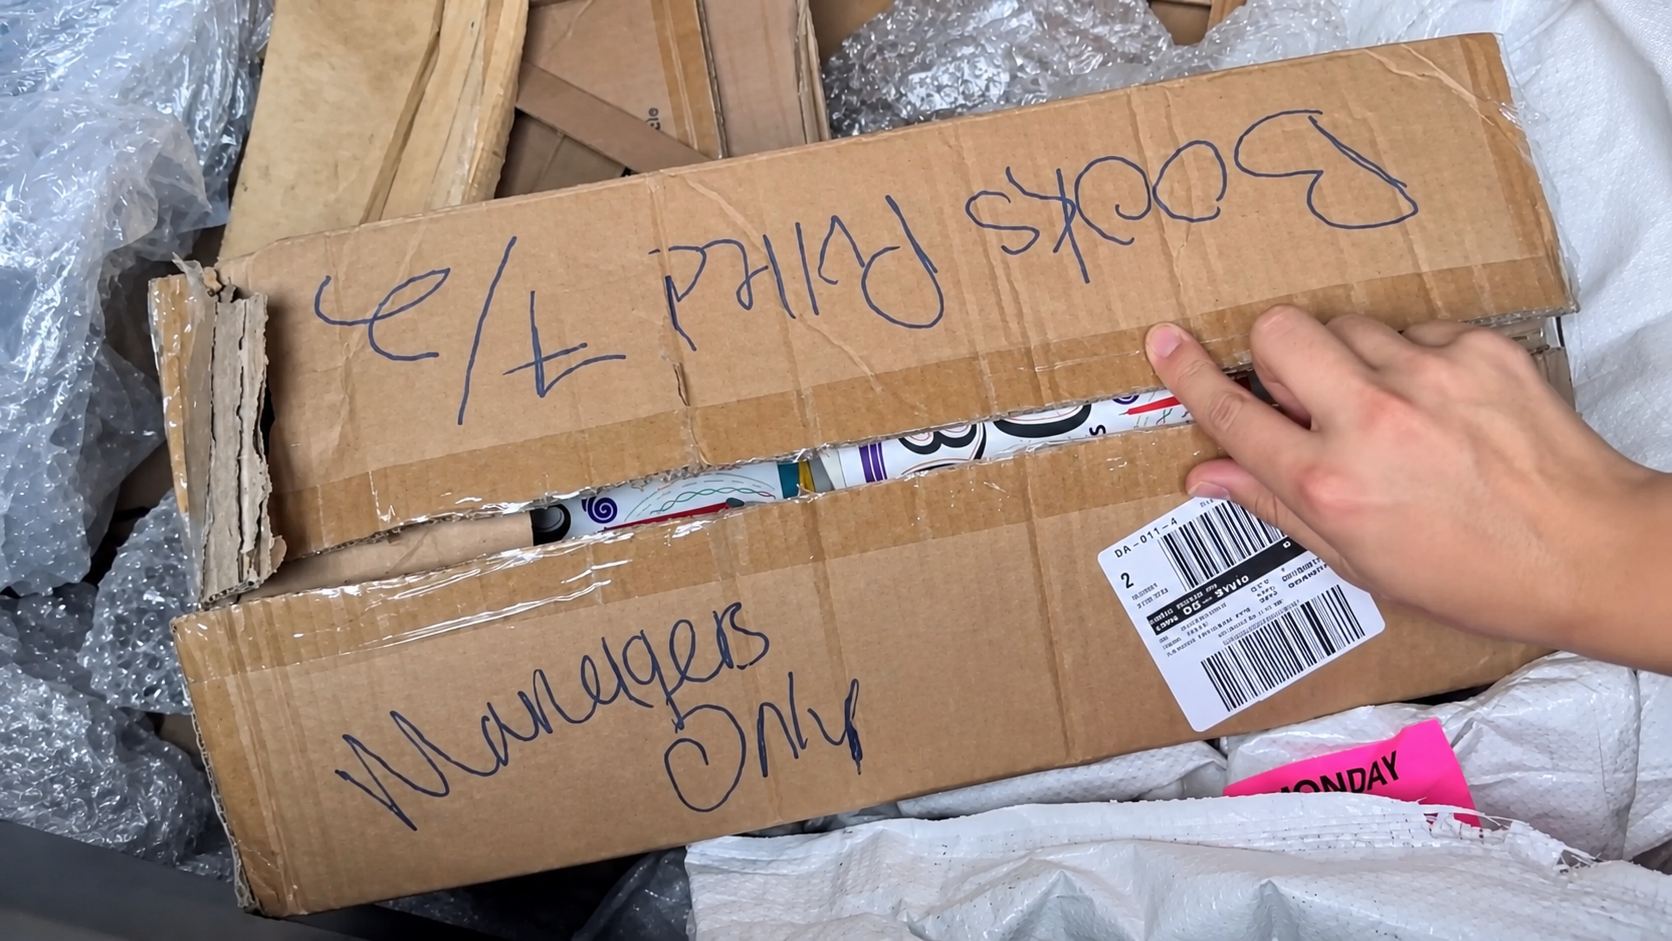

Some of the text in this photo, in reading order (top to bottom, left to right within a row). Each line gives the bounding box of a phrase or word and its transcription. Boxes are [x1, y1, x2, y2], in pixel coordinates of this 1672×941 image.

[315, 109, 1419, 427] Books Pulled 7/2
[1120, 571, 1135, 590] 2
[664, 671, 863, 812] Only
[1280, 749, 1401, 794] ONDAY
